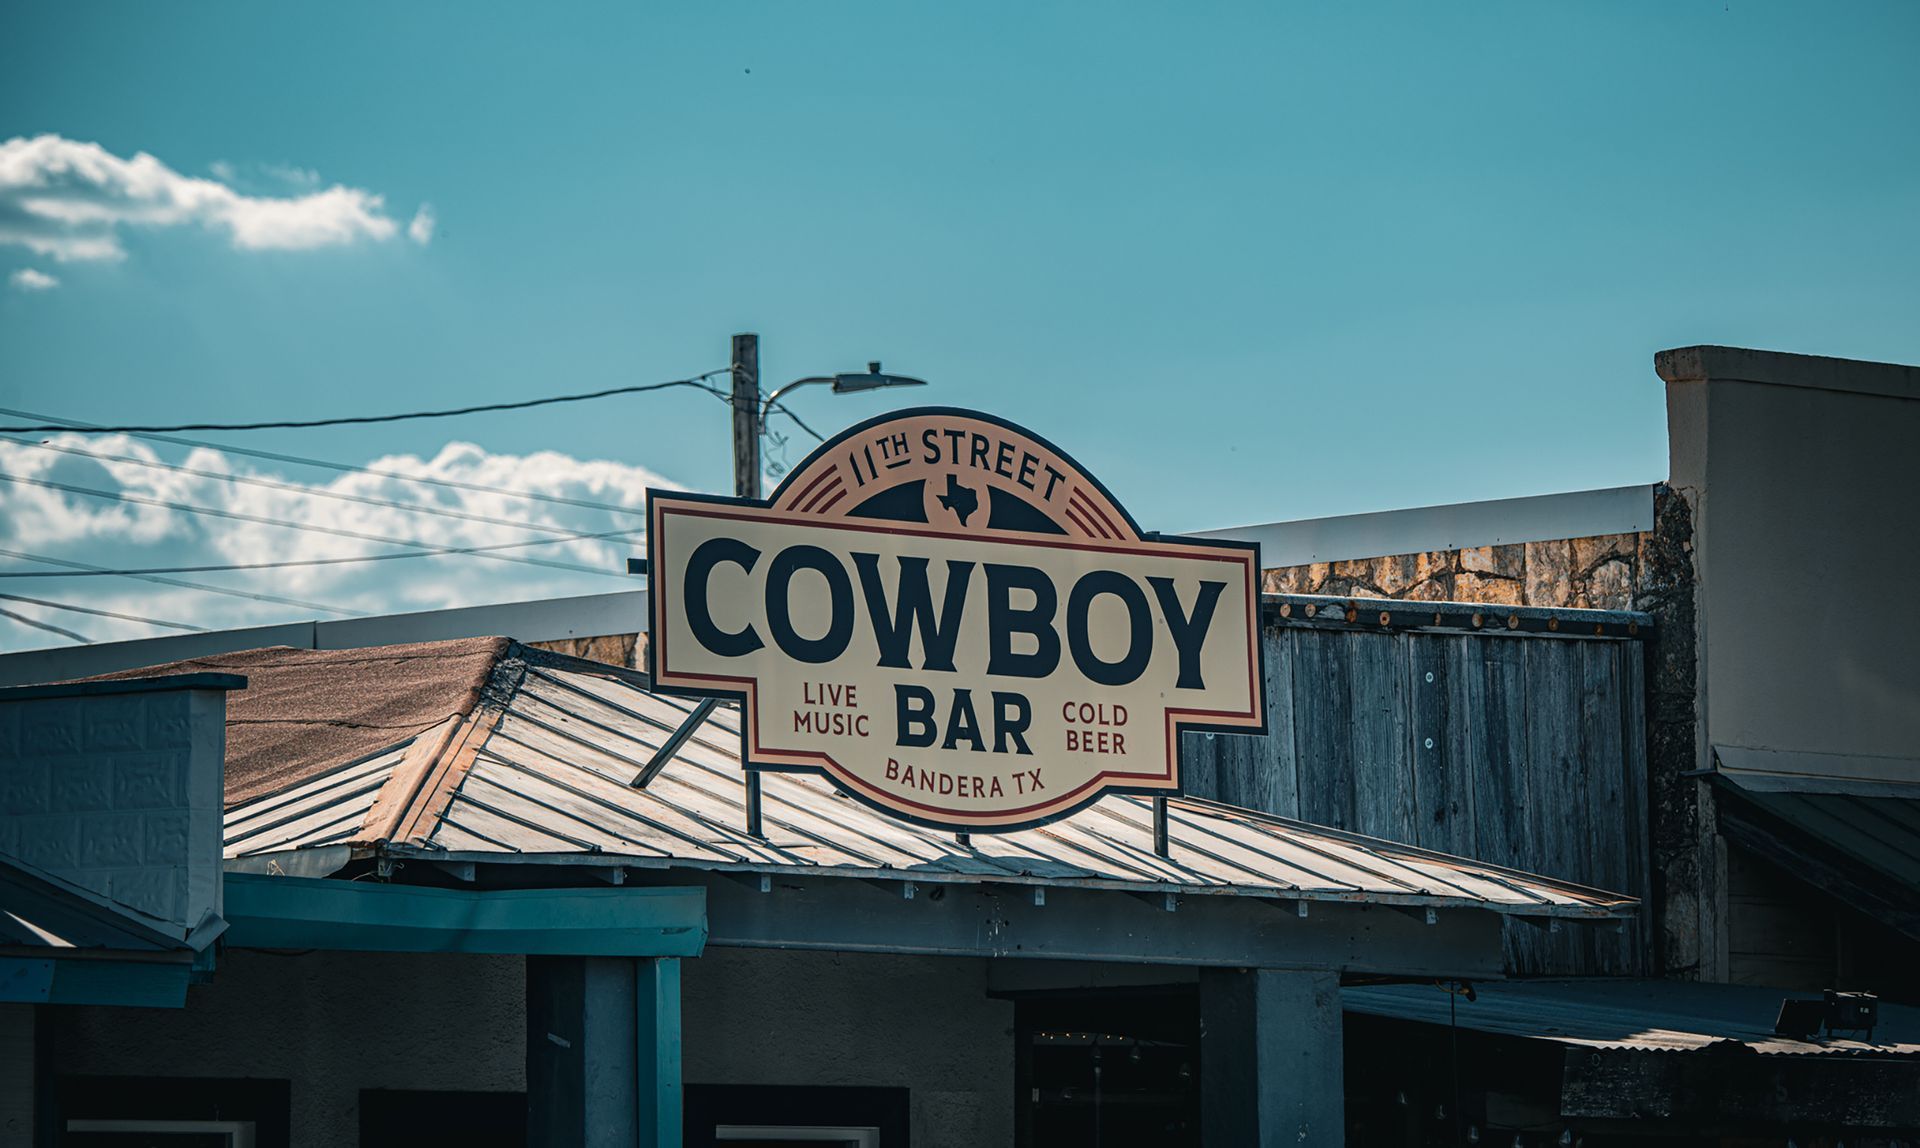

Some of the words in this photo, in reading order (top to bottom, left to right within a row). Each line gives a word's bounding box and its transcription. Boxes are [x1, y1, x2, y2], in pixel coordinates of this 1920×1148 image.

[848, 432, 911, 488] 11TH
[922, 428, 1067, 502] STREET
[684, 537, 1228, 691] COWBOY
[803, 681, 858, 708] LIVE
[793, 710, 869, 737] MUSIC
[893, 683, 1034, 756] BAR
[1062, 701, 1128, 727] COLD
[1066, 729, 1127, 755] BEER
[885, 757, 1004, 798] BANDERA
[1012, 767, 1045, 795] TX
